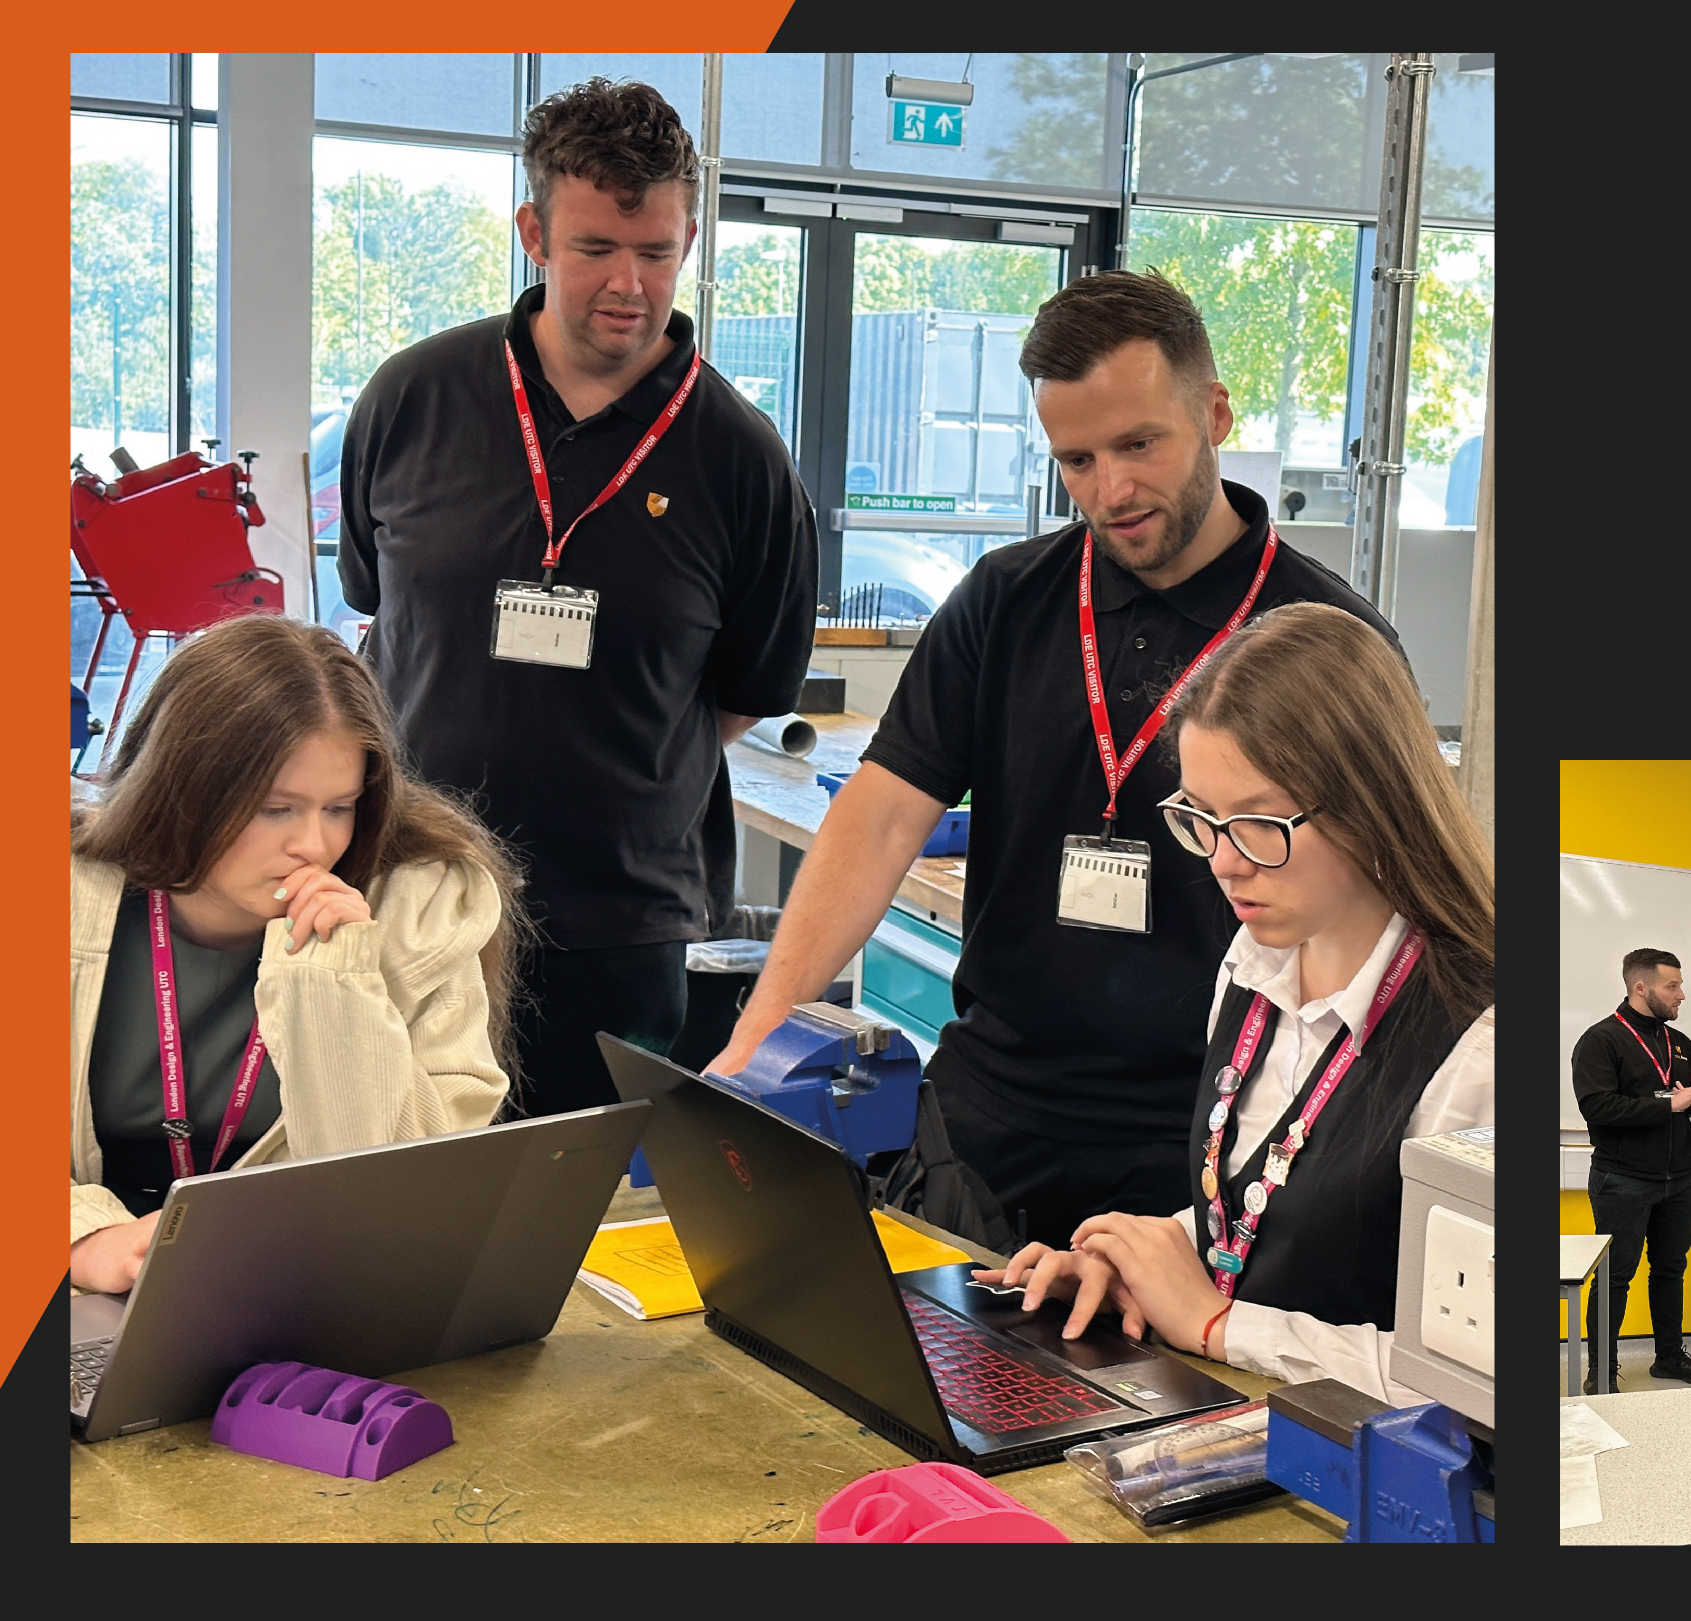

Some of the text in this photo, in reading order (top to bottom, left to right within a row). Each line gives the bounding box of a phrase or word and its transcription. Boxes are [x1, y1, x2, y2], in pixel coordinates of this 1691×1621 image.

[667, 366, 699, 418] LDE UTC VISITOR
[521, 413, 542, 474] LDE UTC VISITOR
[616, 434, 657, 487] LDE UTC VISITOR
[861, 495, 954, 512] Push bar to open
[1080, 575, 1088, 608] VISITOR
[1227, 569, 1265, 632] LDE UTC VISITOR
[1083, 633, 1101, 705] LDE UTC VISITOR
[1159, 652, 1210, 716] LDE UTC VISITOR
[1099, 733, 1111, 752] LDE
[1104, 752, 1115, 771] UTC
[1120, 738, 1147, 769] VISITOR
[152, 889, 165, 948] London Desig
[1376, 932, 1422, 1005] Engineering UTC
[158, 970, 179, 1113] London Design & Engineering UTC
[1236, 997, 1269, 1070] esign & Engineeri
[237, 1045, 262, 1092] Engineering
[1322, 1079, 1332, 1091] &
[1327, 1051, 1349, 1082] Design
[234, 1092, 247, 1109] UTC
[161, 1205, 185, 1241] Lenovo
